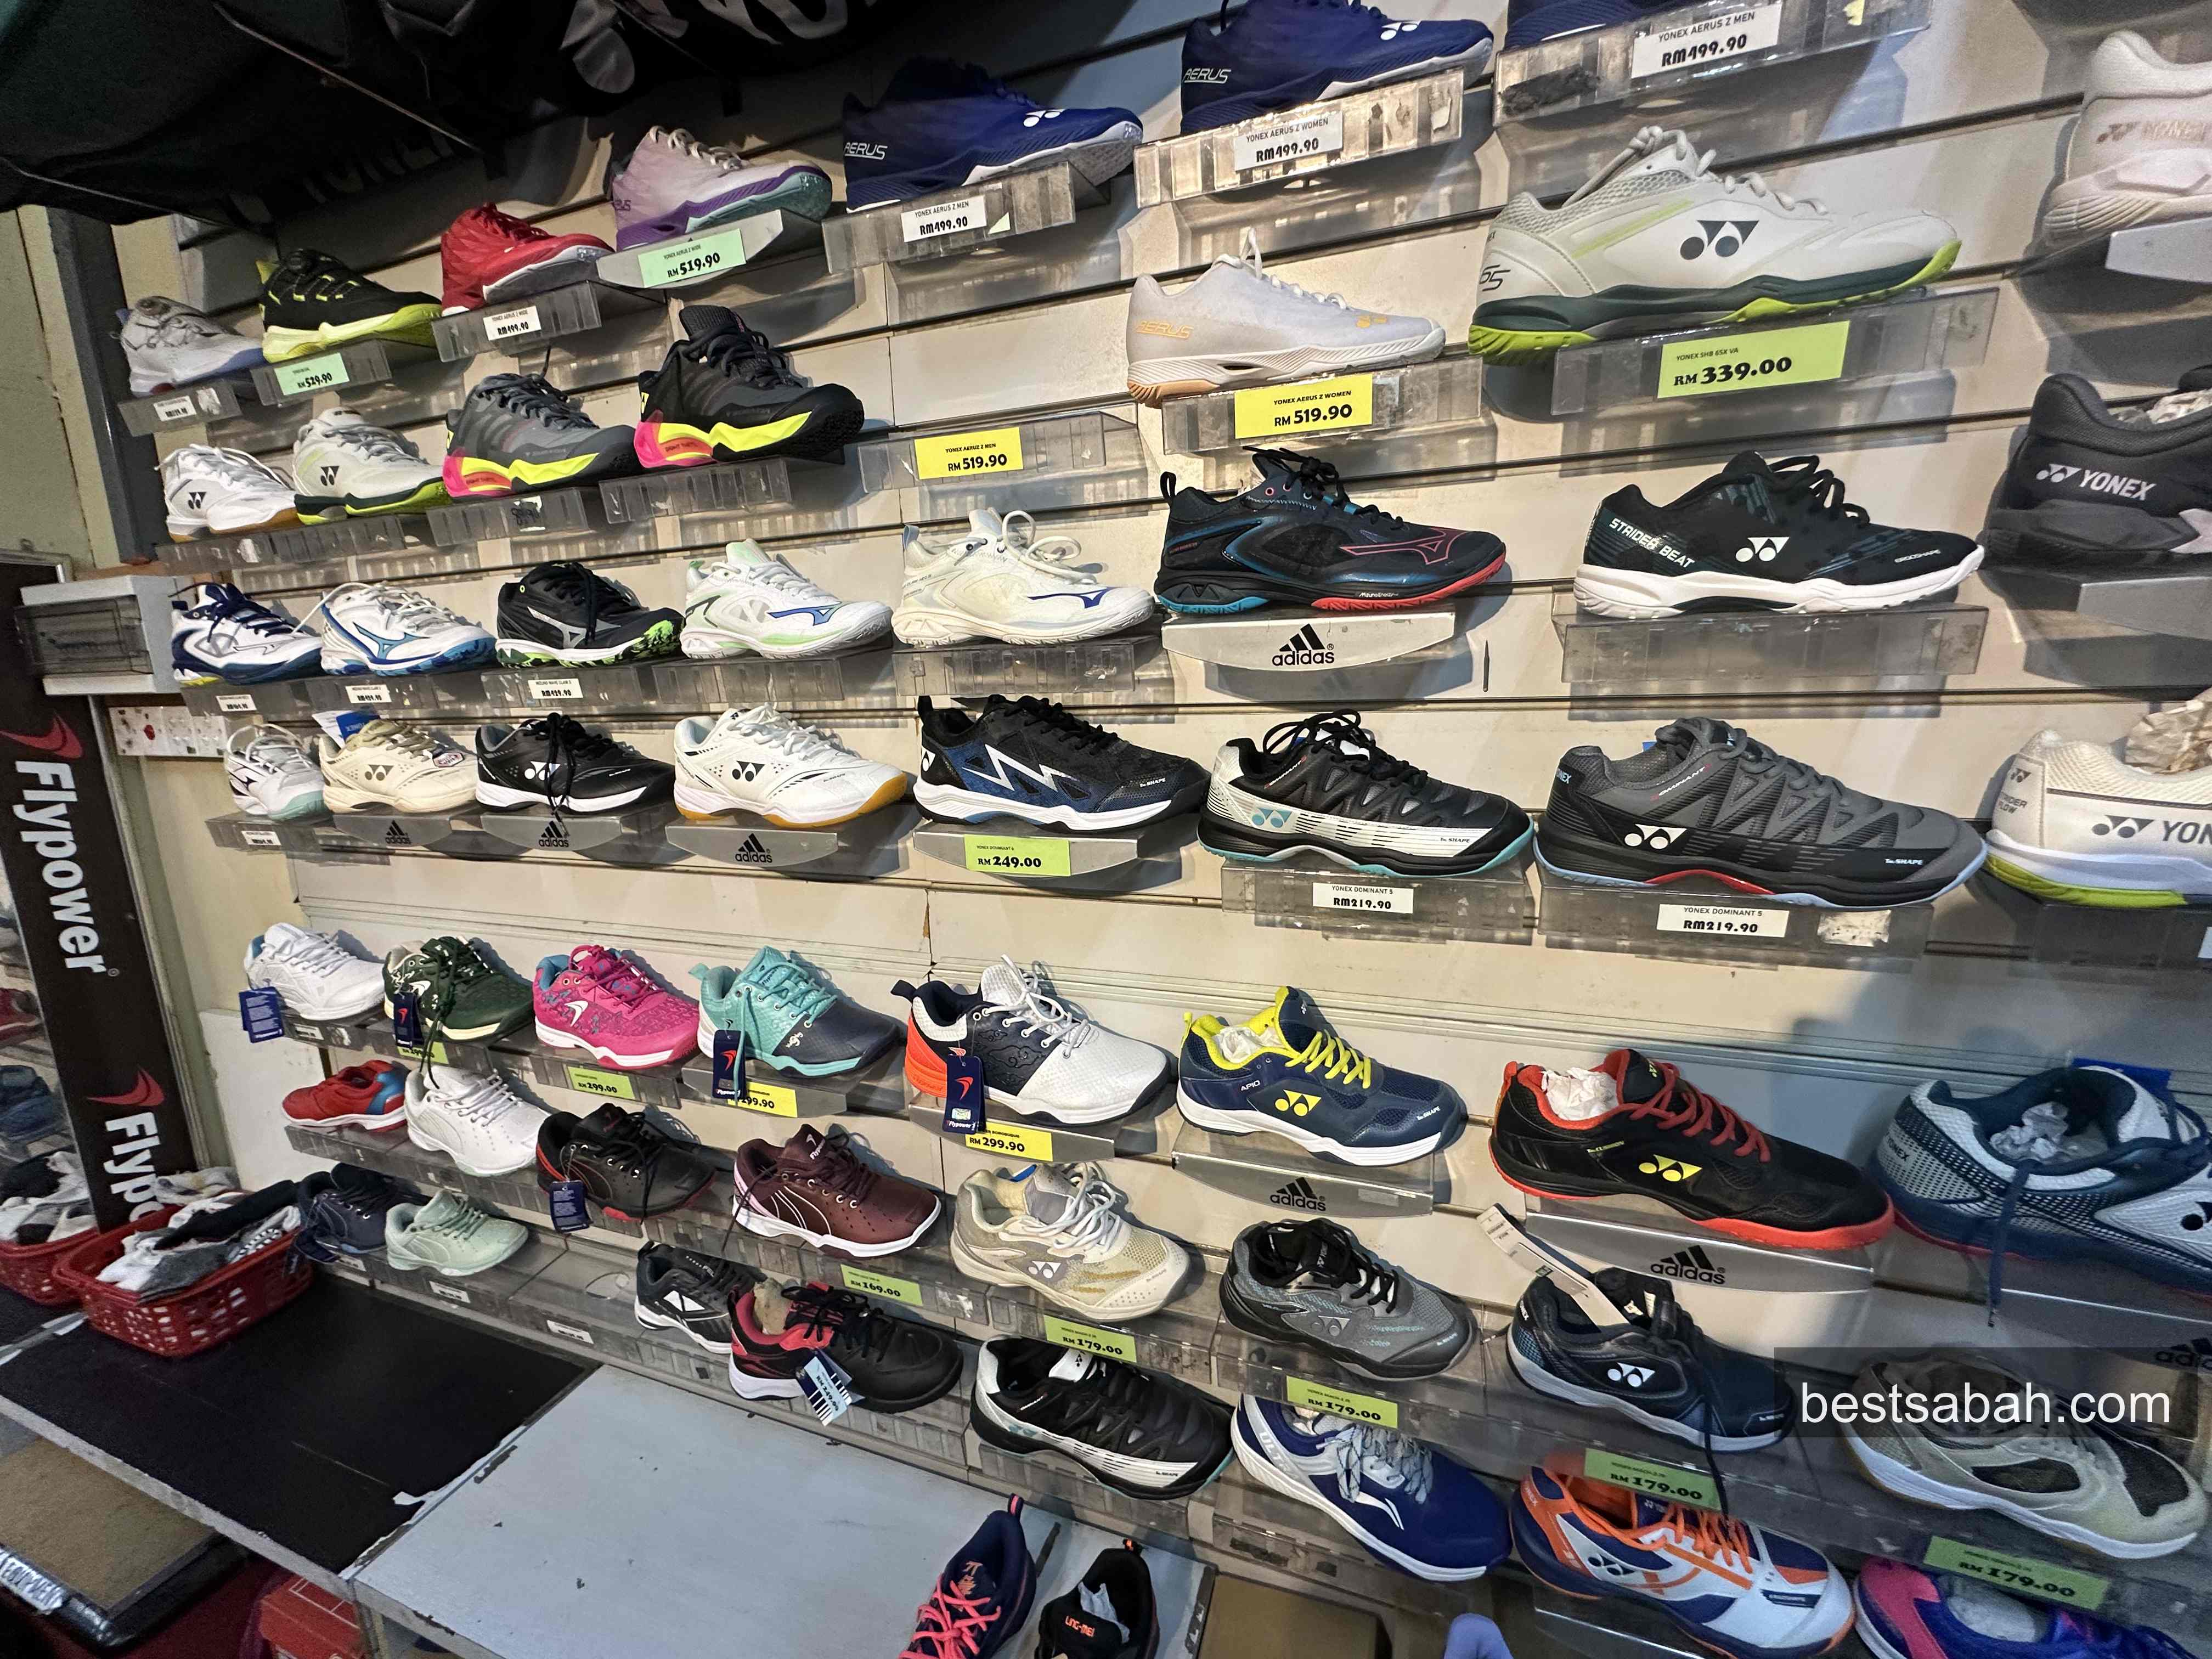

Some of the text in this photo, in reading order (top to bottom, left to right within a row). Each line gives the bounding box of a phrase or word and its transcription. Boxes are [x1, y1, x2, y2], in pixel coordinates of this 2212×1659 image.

[1658, 12, 1756, 42] YONEX AERUS Z MEN
[1662, 33, 1747, 67] RM499.90
[1183, 68, 1232, 83] AERUS
[1246, 133, 1268, 143] YONEX
[1270, 128, 1293, 138] AERUS
[1301, 117, 1329, 132] WOMEN
[843, 142, 888, 160] AERUS
[1256, 138, 1319, 162] RM499.90
[915, 209, 932, 218] YONEX
[933, 206, 951, 215] AERUS
[957, 201, 969, 210] MEN
[919, 216, 968, 235] RM499.90
[667, 252, 720, 278] RM 519.90
[497, 321, 529, 336] RM499.90
[1136, 321, 1193, 340] AERUS
[1676, 352, 1699, 361] YONEX
[1700, 350, 1713, 358] SHB
[305, 373, 332, 387] 529.90
[1673, 357, 1792, 386] RM 339.00
[1296, 395, 1318, 403] AERUS
[1325, 390, 1351, 399] WOMEN
[1274, 404, 1353, 427] RM 519.90
[948, 454, 1007, 472] RM 519.90
[2079, 469, 2157, 501] YONEX
[1609, 518, 1695, 568] STRIDER BEAT
[1272, 647, 1334, 667] adidas
[538, 836, 569, 848] adidas
[735, 849, 773, 864] adidas
[992, 856, 1041, 867] 249.00
[13, 761, 106, 975] Flypower
[1333, 898, 1392, 910] RM219.90
[1712, 908, 1756, 917] DOMINANT
[1683, 919, 1759, 934] RM219.90
[588, 1082, 618, 1093] 299.00
[1240, 1080, 1261, 1091] APIO
[969, 1136, 1025, 1153] RM 299.90
[1269, 1192, 1326, 1212] adidas
[1650, 1262, 1725, 1284] adidas
[863, 1282, 901, 1297] 169.00
[1062, 1336, 1123, 1355] RM 179.00
[1307, 1398, 1381, 1421] RM 179.00
[1610, 1472, 1703, 1500] RM 179.00
[1985, 1566, 2076, 1598] 179.00
